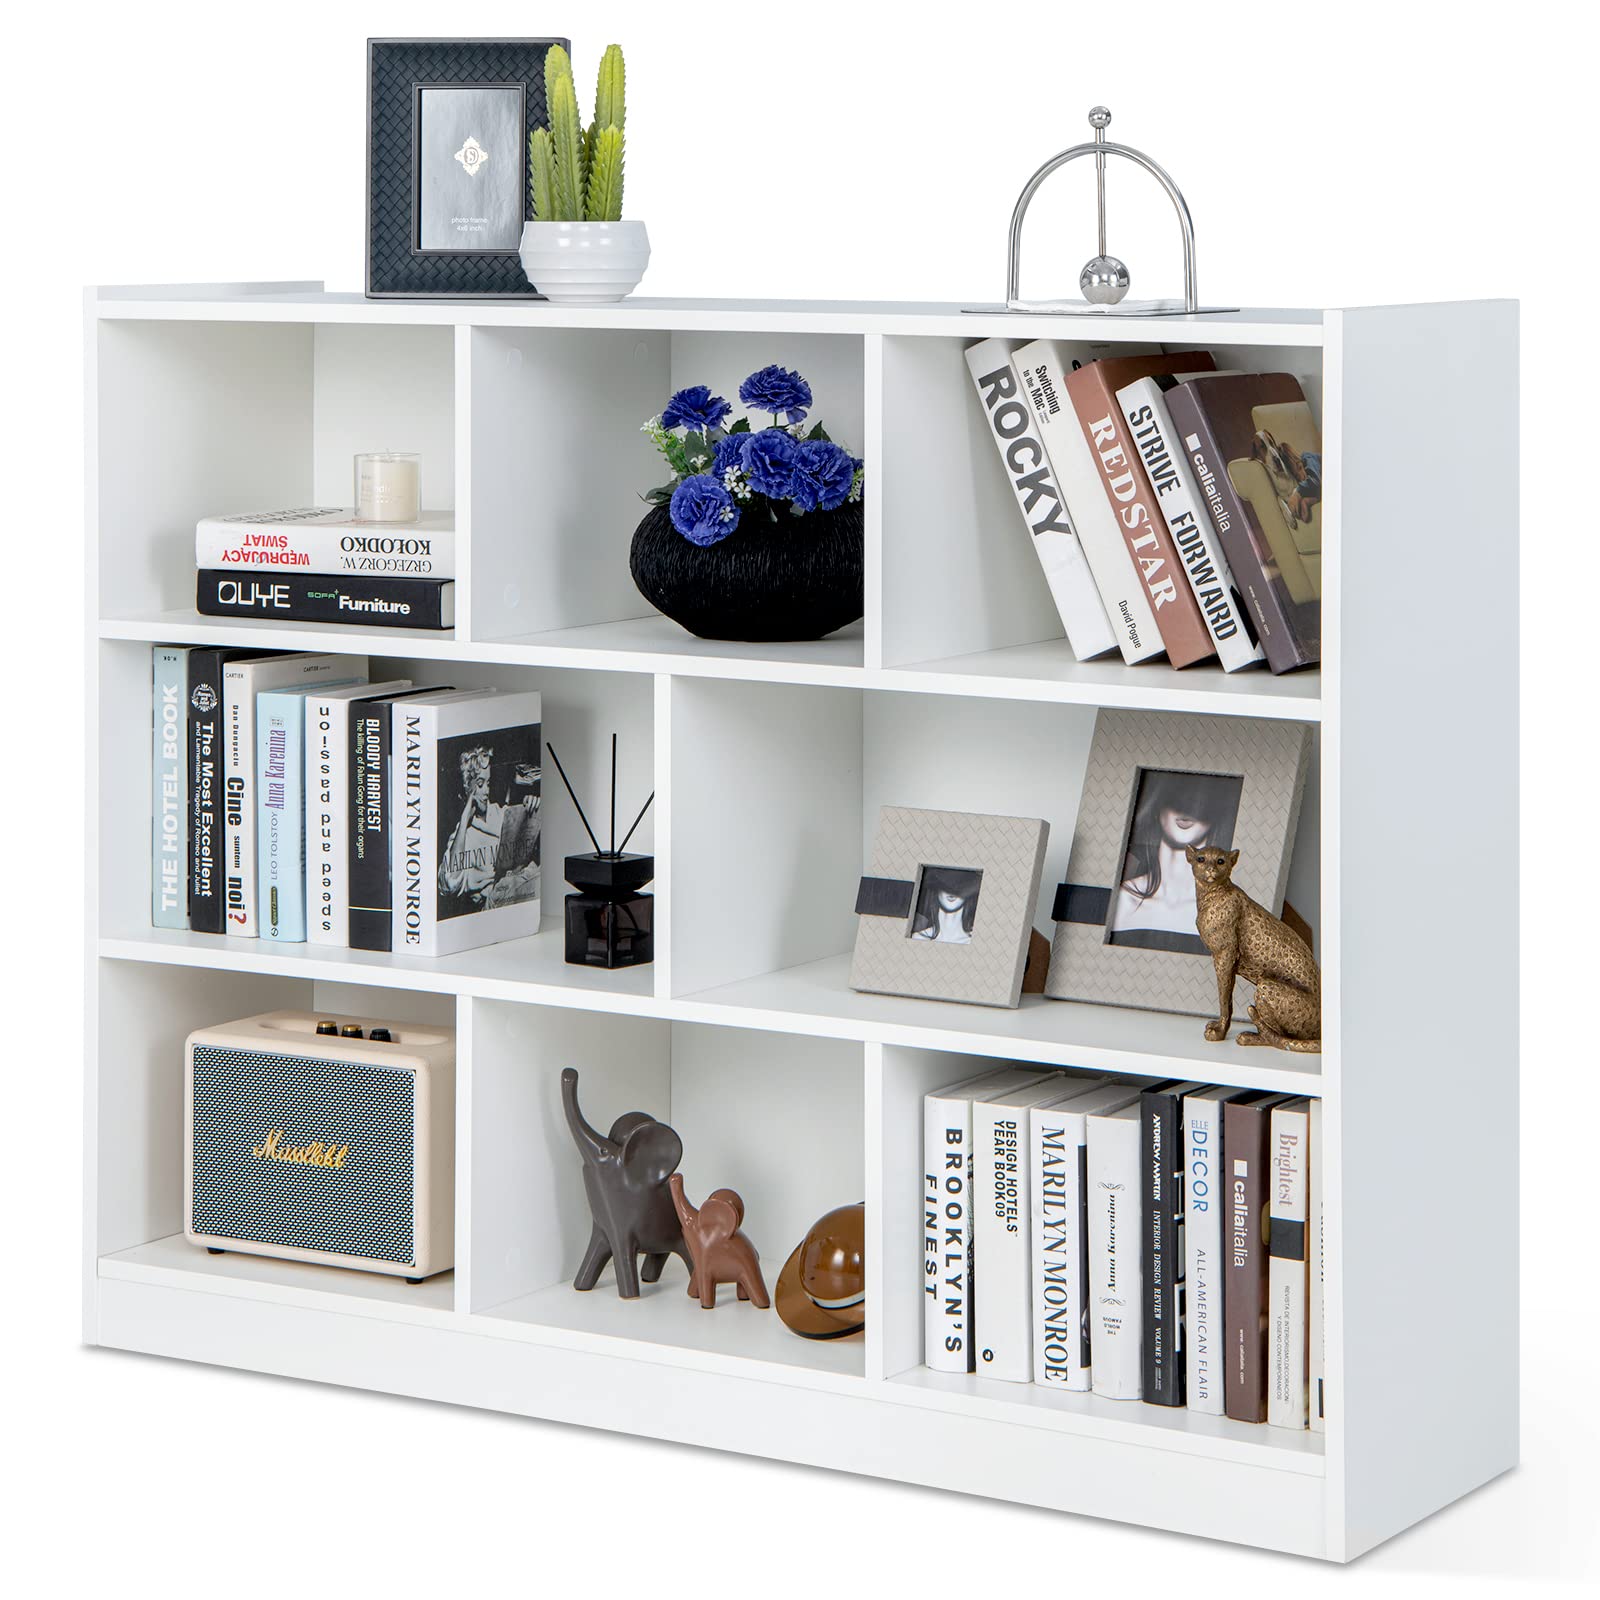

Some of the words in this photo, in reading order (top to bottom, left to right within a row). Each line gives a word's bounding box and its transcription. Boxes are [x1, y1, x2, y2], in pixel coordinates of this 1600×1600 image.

[1023, 369, 1030, 377] to
[1026, 378, 1034, 388] the
[1035, 365, 1061, 415] Switching
[1030, 387, 1046, 411] Mac
[977, 364, 1072, 537] ROCKY
[1194, 453, 1231, 533] caliaitalia
[243, 534, 288, 551] ŚWIAT
[1129, 405, 1181, 497] STRIVE
[1170, 511, 1238, 641] FORWARD
[221, 547, 310, 566] WĘDRUJĄCY
[340, 536, 432, 556] KOŁODKO
[359, 557, 432, 573] GRZEGORZ
[339, 595, 411, 615] Furniture
[1118, 600, 1134, 624] David
[1127, 623, 1142, 649] Pogue
[162, 683, 178, 760] BOOK
[201, 721, 214, 756] The
[356, 718, 364, 732] The
[265, 729, 286, 779] Karenina
[355, 733, 365, 755] killing
[357, 756, 364, 765] of
[366, 718, 381, 770] BLOODY
[201, 762, 214, 807] Most
[357, 765, 365, 785] Falun
[406, 716, 421, 830] MARILYN
[162, 766, 178, 852] HOTEL
[227, 777, 245, 826] Cine
[265, 783, 285, 810] Anna
[356, 786, 366, 804] Gong
[367, 773, 382, 833] HARVEST
[270, 811, 278, 856] TOLSTOY
[355, 834, 365, 859] organs
[357, 817, 366, 834] their
[201, 812, 214, 897] Excellent
[233, 835, 241, 868] suntem
[443, 847, 487, 873] MARILYN
[161, 859, 178, 912] THE
[406, 837, 421, 944] MONROE
[994, 1120, 1005, 1156] YEAR
[1005, 1120, 1017, 1172] DESIGN
[1152, 1113, 1161, 1161] ANDREW
[1191, 1119, 1209, 1130] ELLE
[1042, 1125, 1067, 1256] MARILYN
[1152, 1160, 1161, 1201] MARTIN
[1192, 1130, 1209, 1213] DECOR
[1273, 1133, 1298, 1207] Brightest
[1006, 1178, 1018, 1233] HOTELS
[1107, 1194, 1116, 1254] Karenina
[1233, 1180, 1249, 1267] caliaitalia
[925, 1174, 937, 1300] FINEST
[1152, 1209, 1161, 1250] INTERIOR
[1108, 1258, 1116, 1292] Anna
[1153, 1253, 1162, 1285] DESIGN
[1043, 1259, 1068, 1382] MONROE
[1153, 1288, 1162, 1320] REVIEW
[1196, 1248, 1208, 1354] ALL-AMERICAN
[1154, 1327, 1162, 1358] VOLUME
[1198, 1359, 1209, 1400] FLAIR
